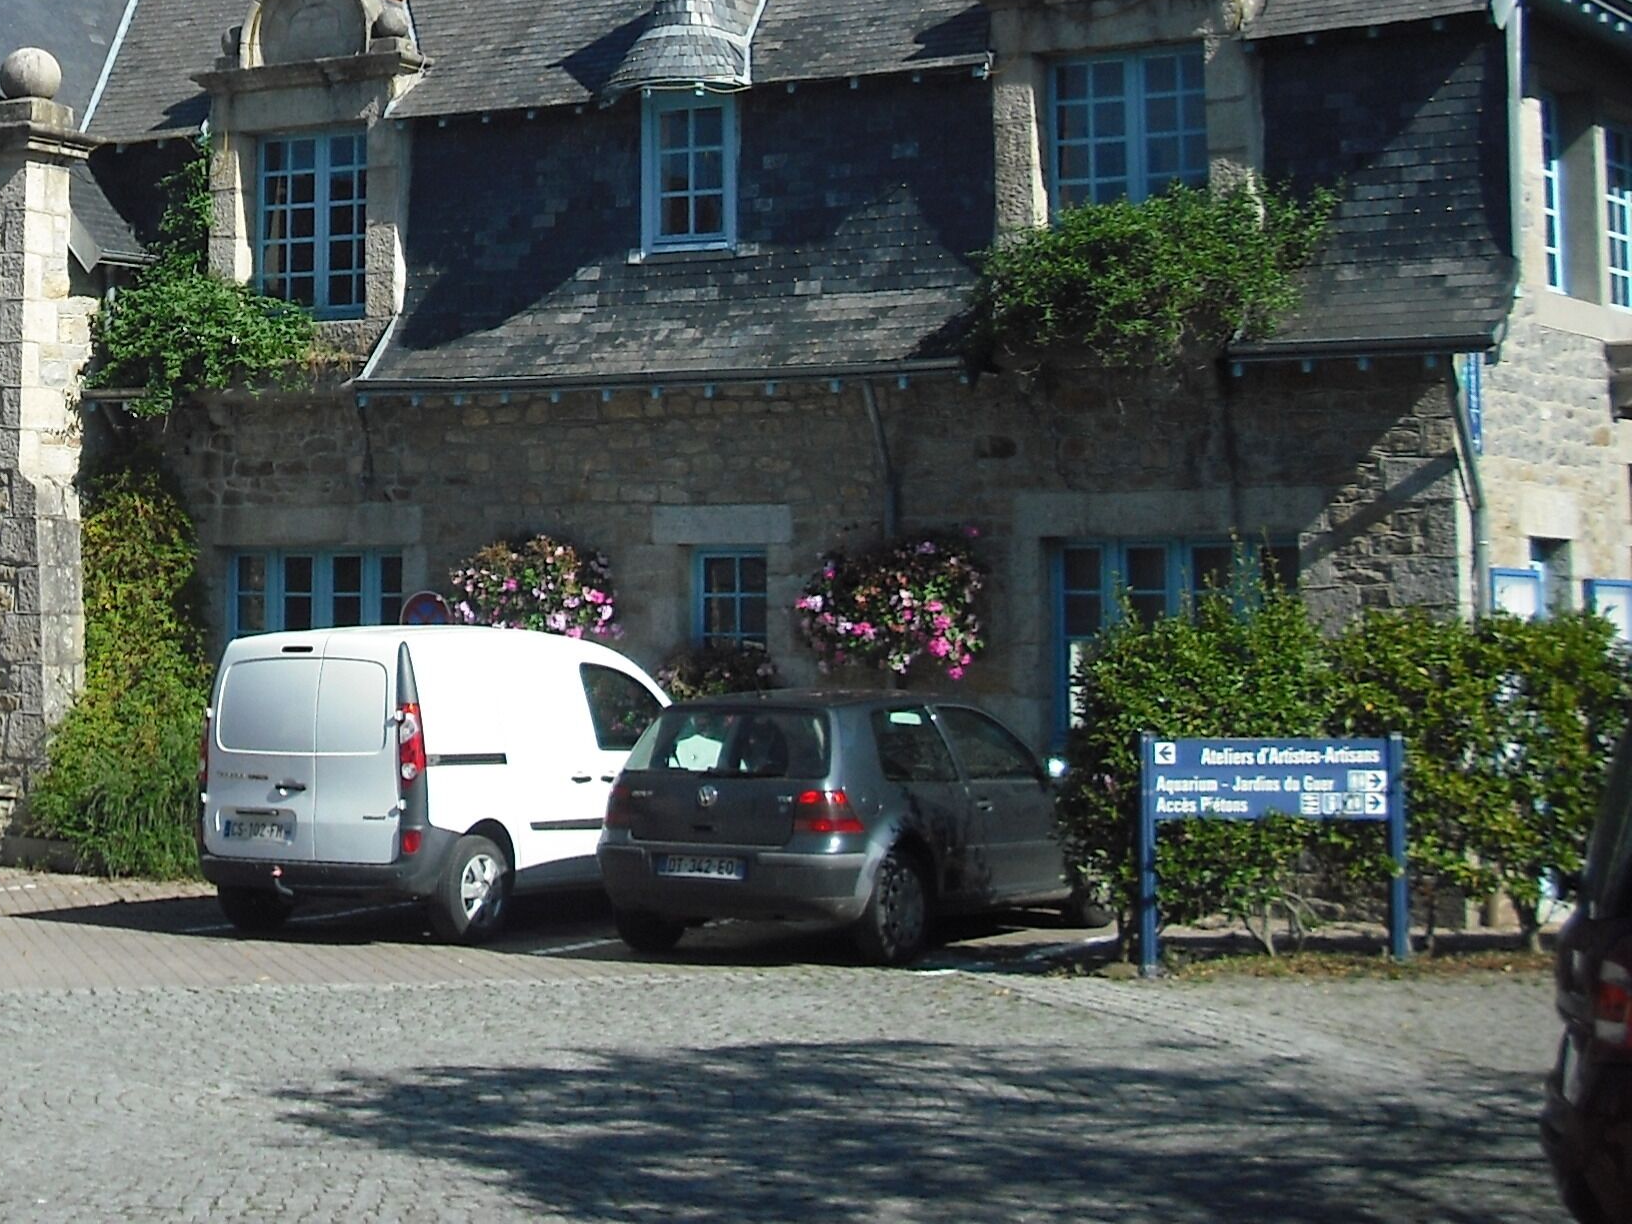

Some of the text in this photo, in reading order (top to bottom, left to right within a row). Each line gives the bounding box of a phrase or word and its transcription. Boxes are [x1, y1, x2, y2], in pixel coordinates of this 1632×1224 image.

[1200, 747, 1255, 765] Ateliers
[1156, 775, 1219, 795] Aquarium
[1232, 775, 1281, 792] Jardins
[1283, 775, 1301, 792] du
[1156, 796, 1198, 813] Accès
